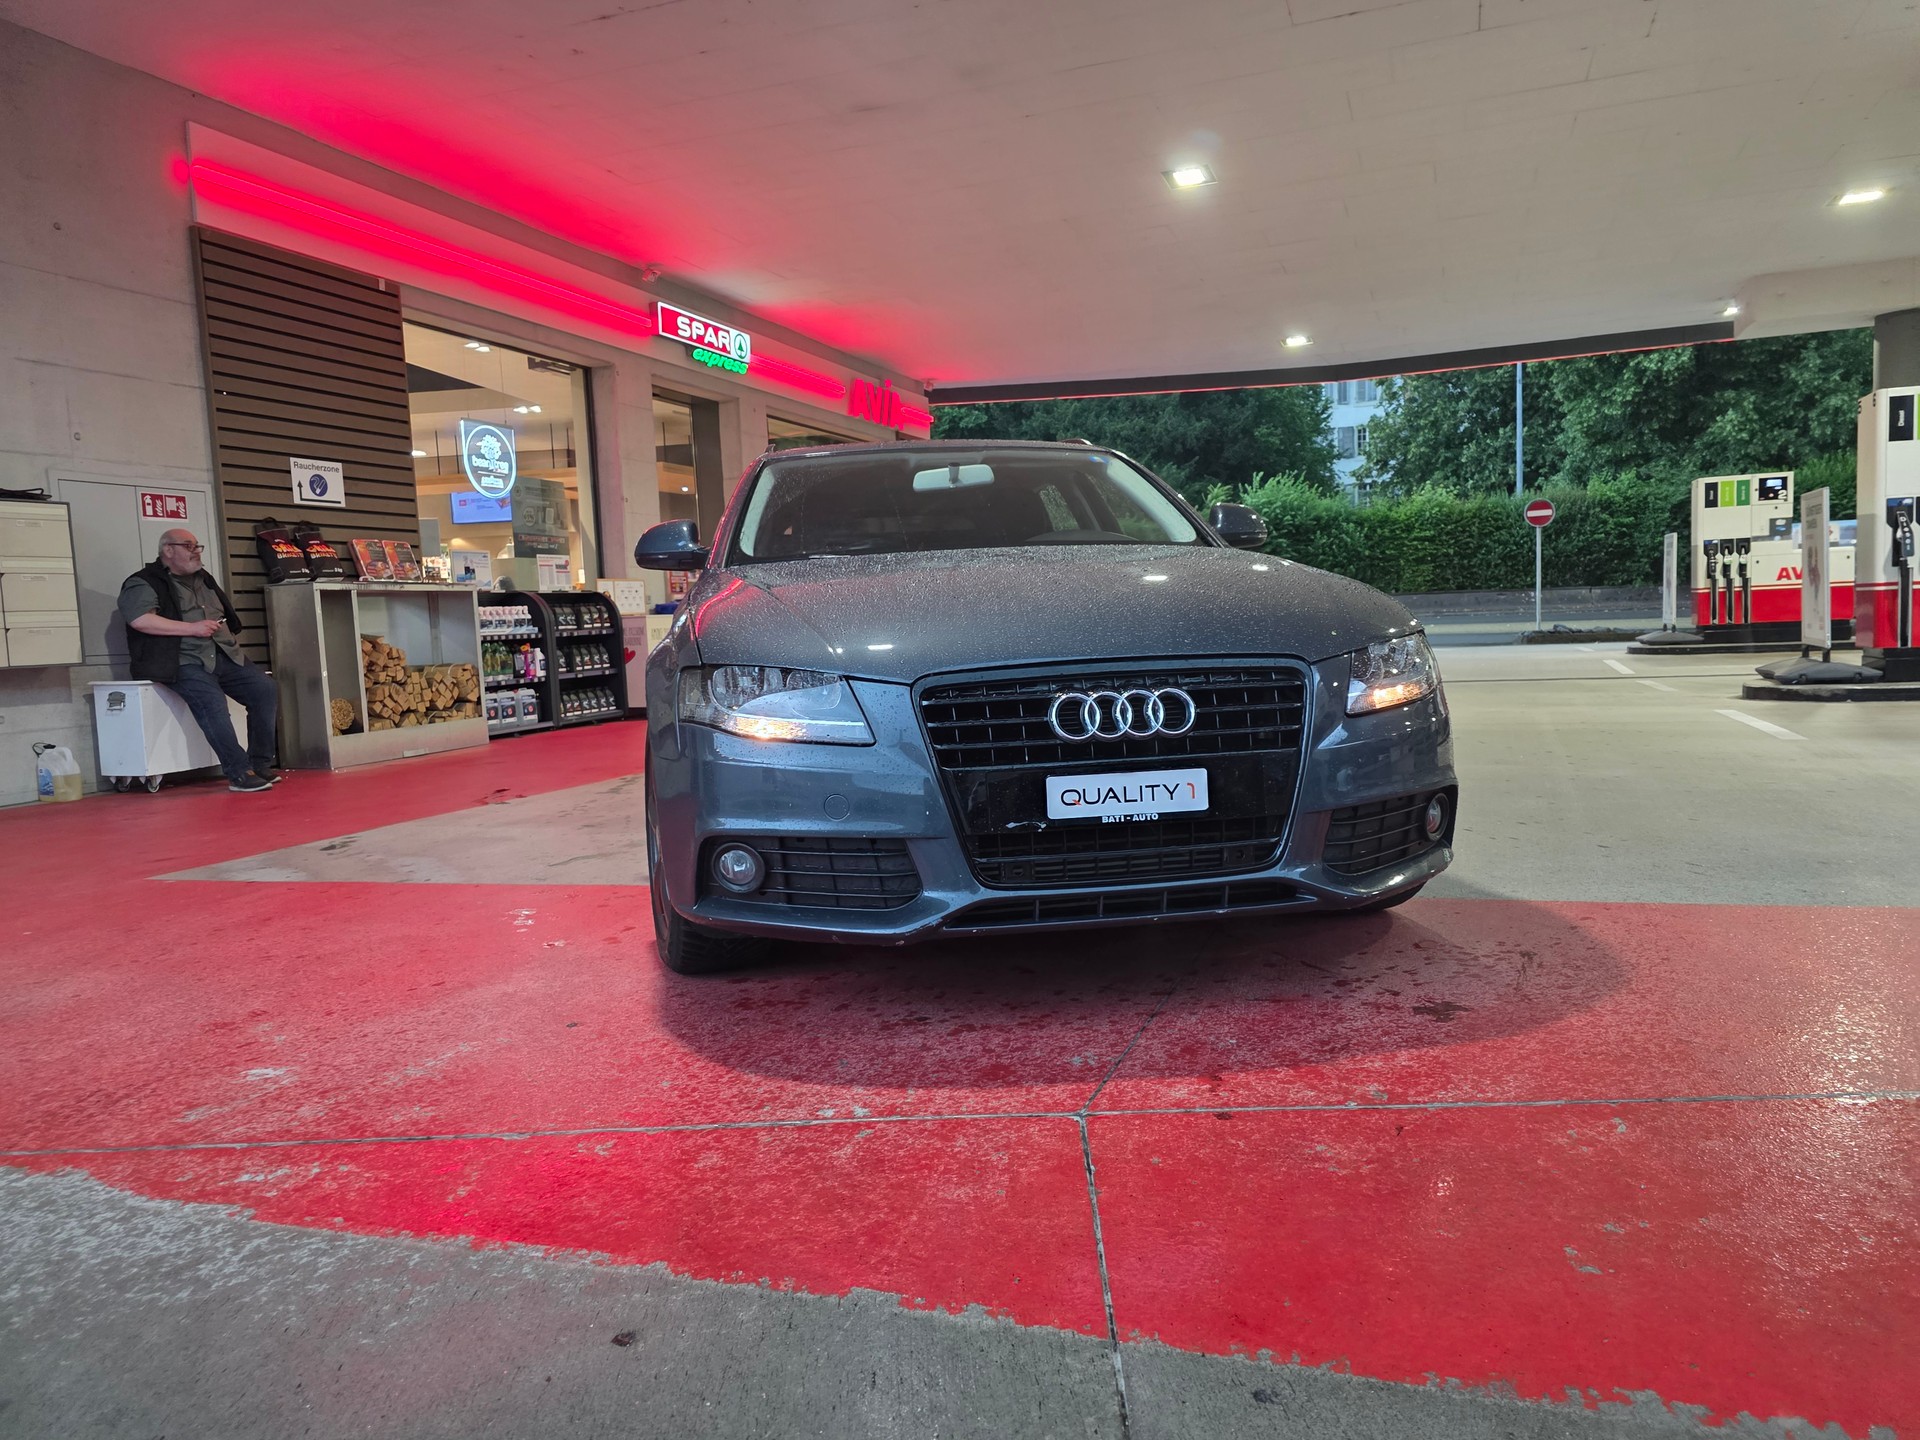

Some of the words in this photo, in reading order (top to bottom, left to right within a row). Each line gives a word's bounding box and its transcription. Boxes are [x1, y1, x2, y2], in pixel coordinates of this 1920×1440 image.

[677, 315, 731, 352] SPAR
[692, 348, 749, 375] express
[293, 461, 340, 473] Raucherzone
[1777, 489, 1788, 500] 2
[1776, 566, 1804, 581] AV
[1060, 783, 1180, 806] QUALITY
[1187, 782, 1196, 799] 1
[1132, 813, 1159, 821] AUTO
